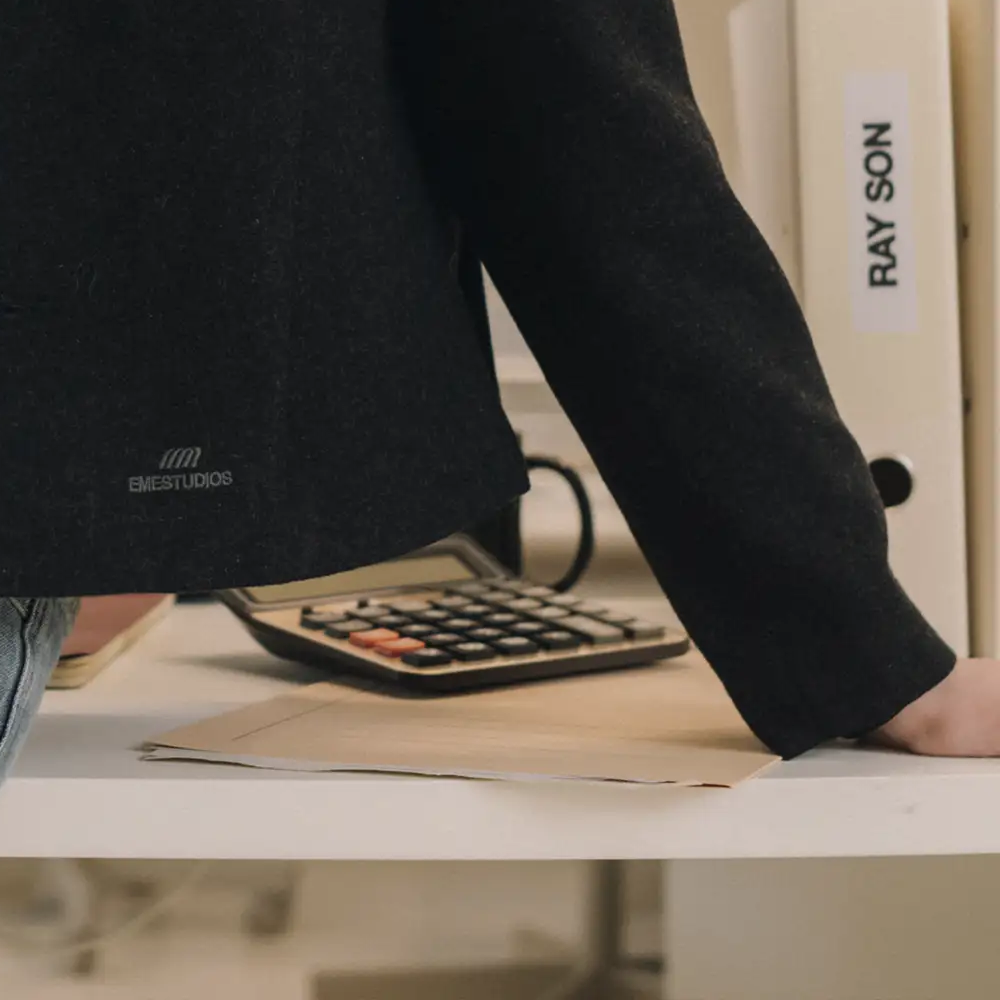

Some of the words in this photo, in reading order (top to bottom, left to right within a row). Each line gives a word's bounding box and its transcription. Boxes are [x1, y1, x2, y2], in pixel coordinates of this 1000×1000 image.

[862, 122, 894, 202] SON
[866, 212, 897, 288] RAY
[128, 470, 233, 493] EMESTUDIOS
